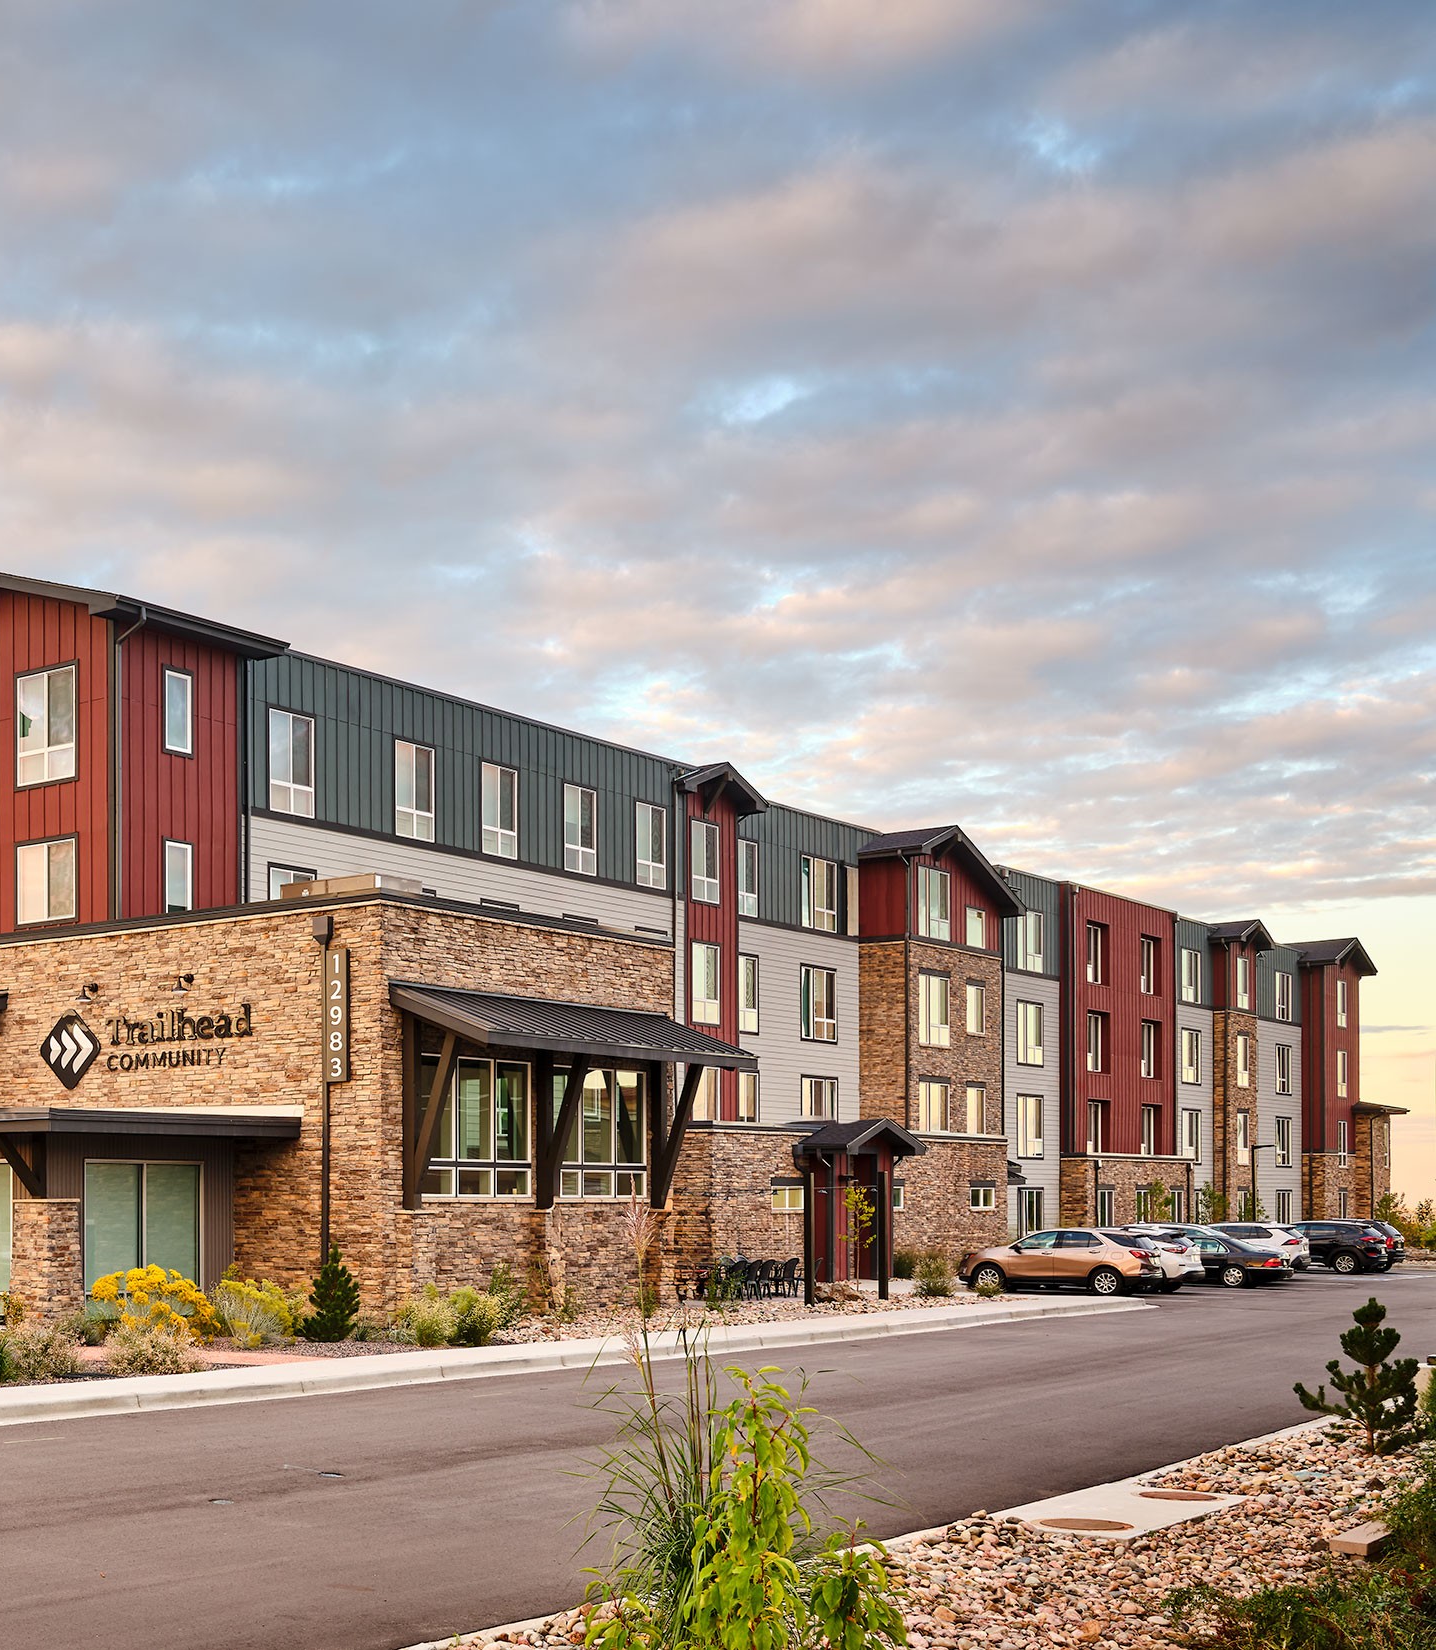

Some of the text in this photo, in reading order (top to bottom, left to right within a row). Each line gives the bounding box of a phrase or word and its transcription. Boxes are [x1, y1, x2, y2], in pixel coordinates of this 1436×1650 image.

[108, 1003, 252, 1045] Trailhead
[329, 954, 343, 1077] 12983
[107, 1048, 226, 1071] COMMUNITY
